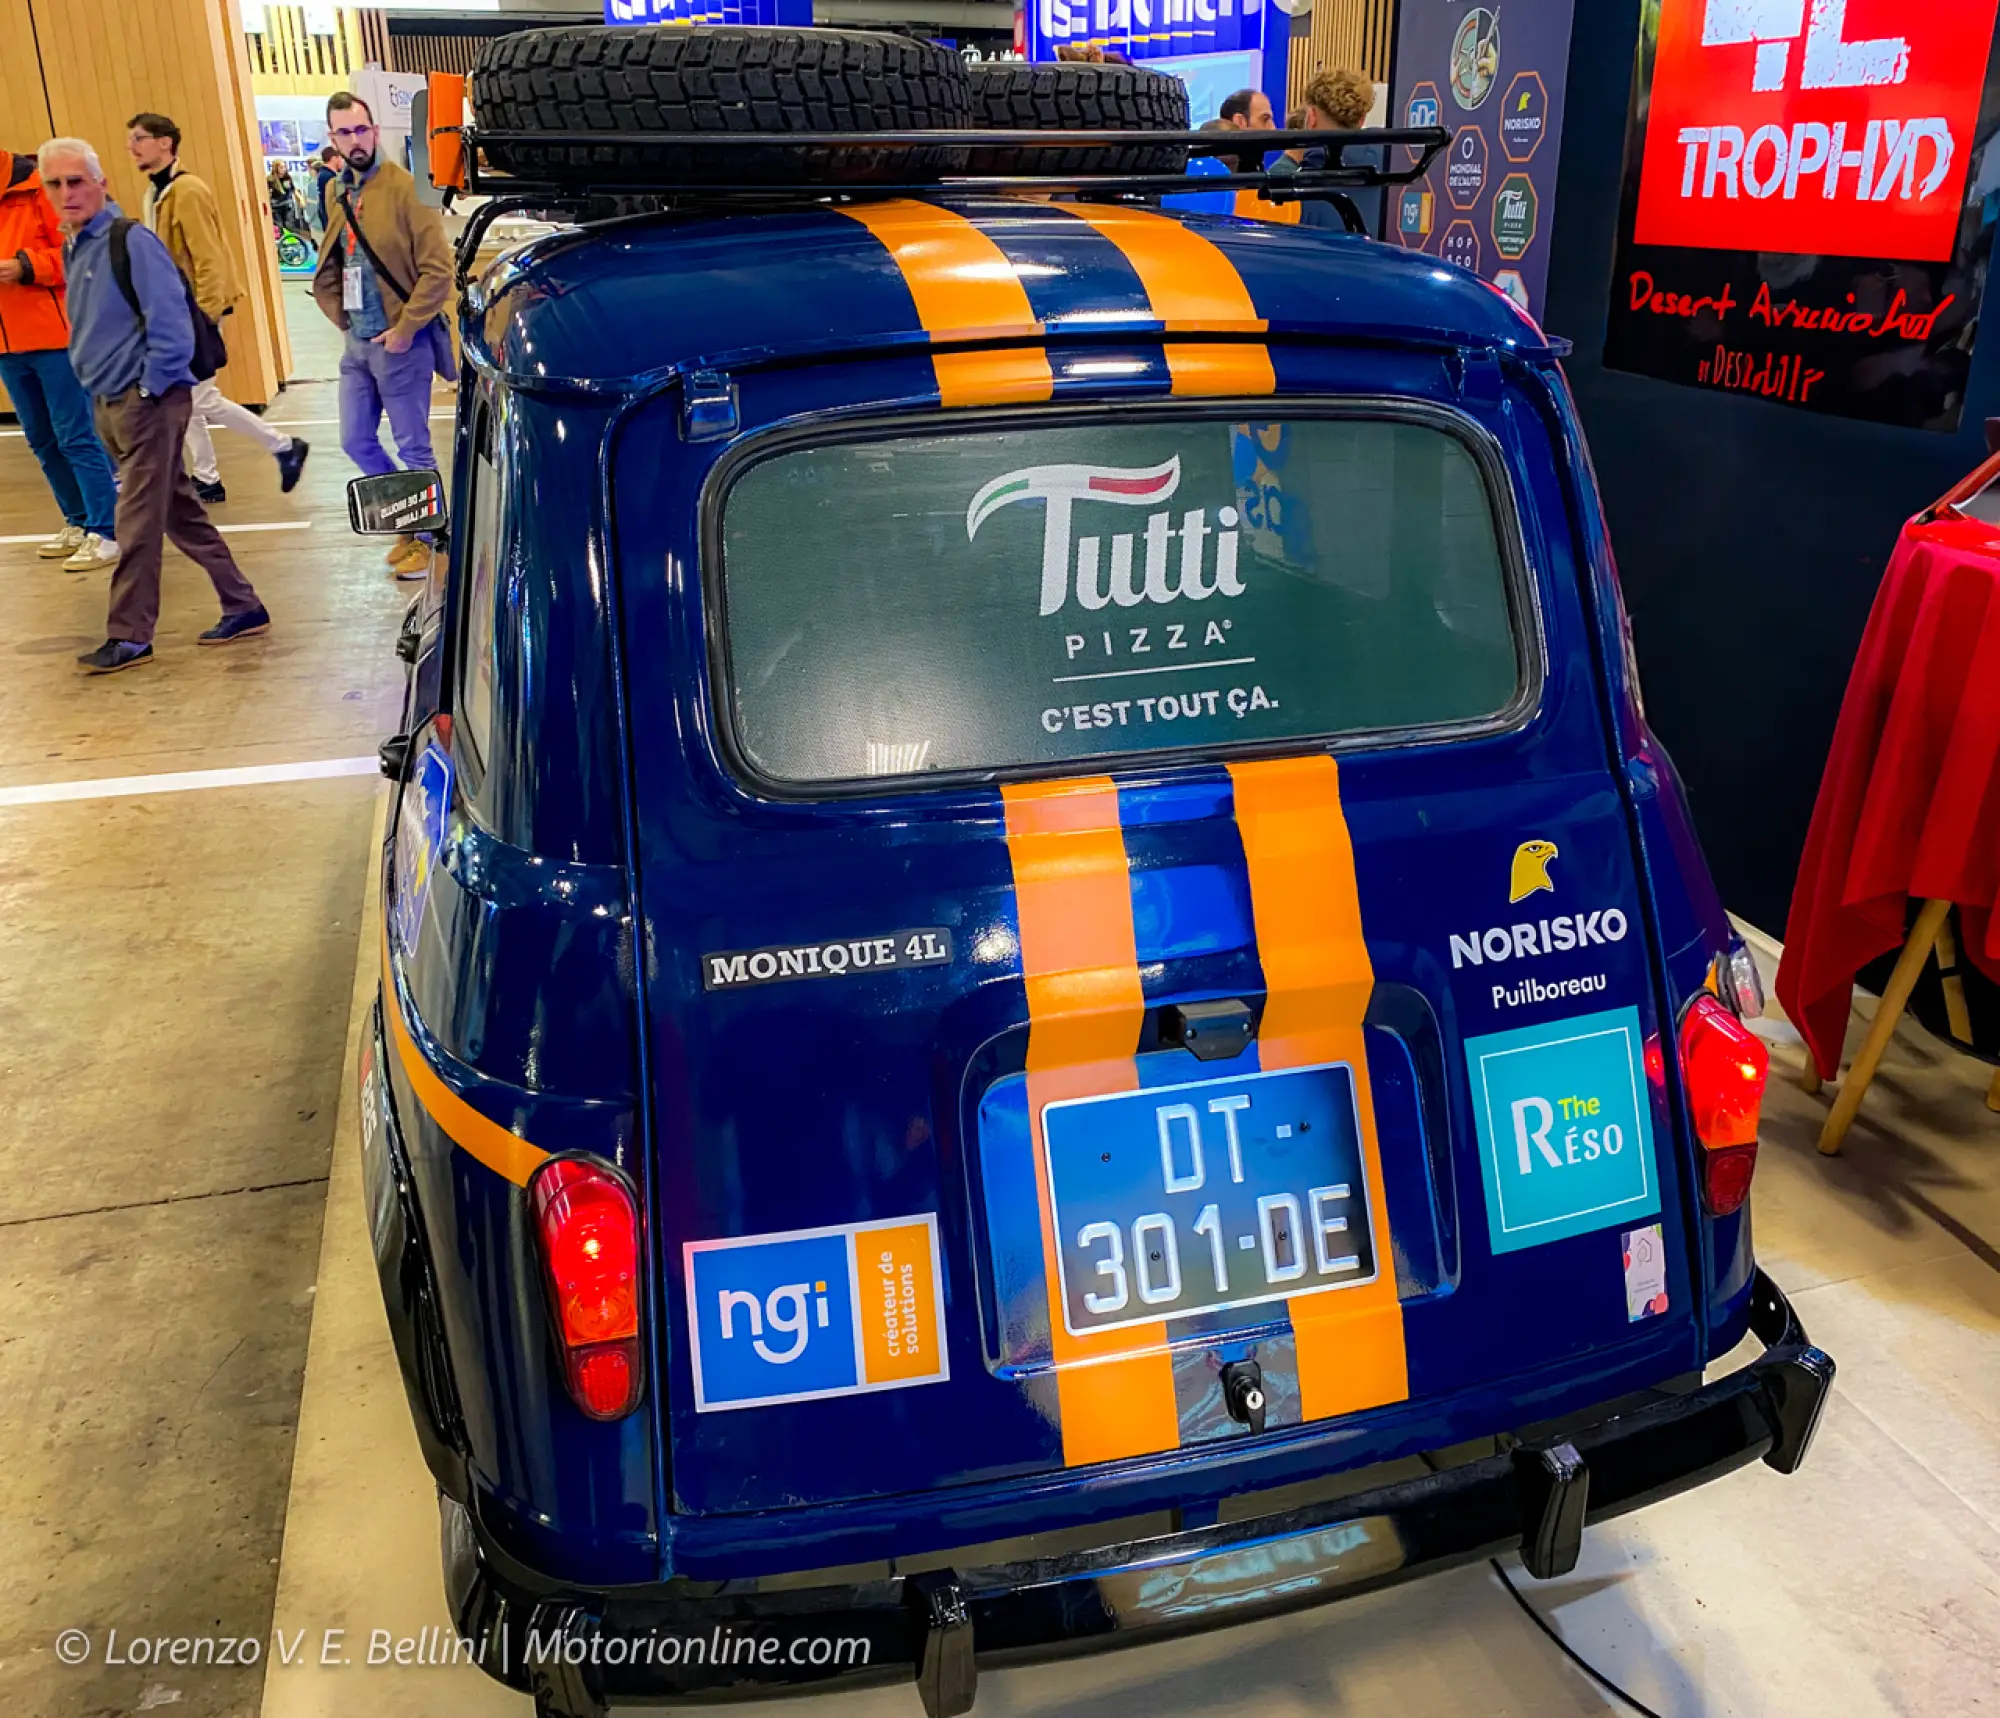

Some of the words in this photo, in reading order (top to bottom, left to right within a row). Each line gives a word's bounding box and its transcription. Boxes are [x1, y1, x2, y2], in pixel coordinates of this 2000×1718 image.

[1629, 270, 1737, 321] Desert
[966, 453, 1247, 616] Tutti
[1041, 700, 1131, 733] C'EST
[1137, 690, 1219, 722] TOUT
[1227, 685, 1279, 718] ÇA.
[710, 938, 897, 985] MONIQUE
[904, 933, 946, 961] 4L
[1449, 908, 1628, 969] NORISKO
[1491, 973, 1607, 1009] Puilboreau
[1557, 1094, 1601, 1121] The
[877, 1251, 894, 1275] de
[1077, 1184, 1360, 1314] 301-DE
[718, 1280, 830, 1365] ngi
[882, 1277, 899, 1357] créateur
[899, 1263, 919, 1355] solutions
